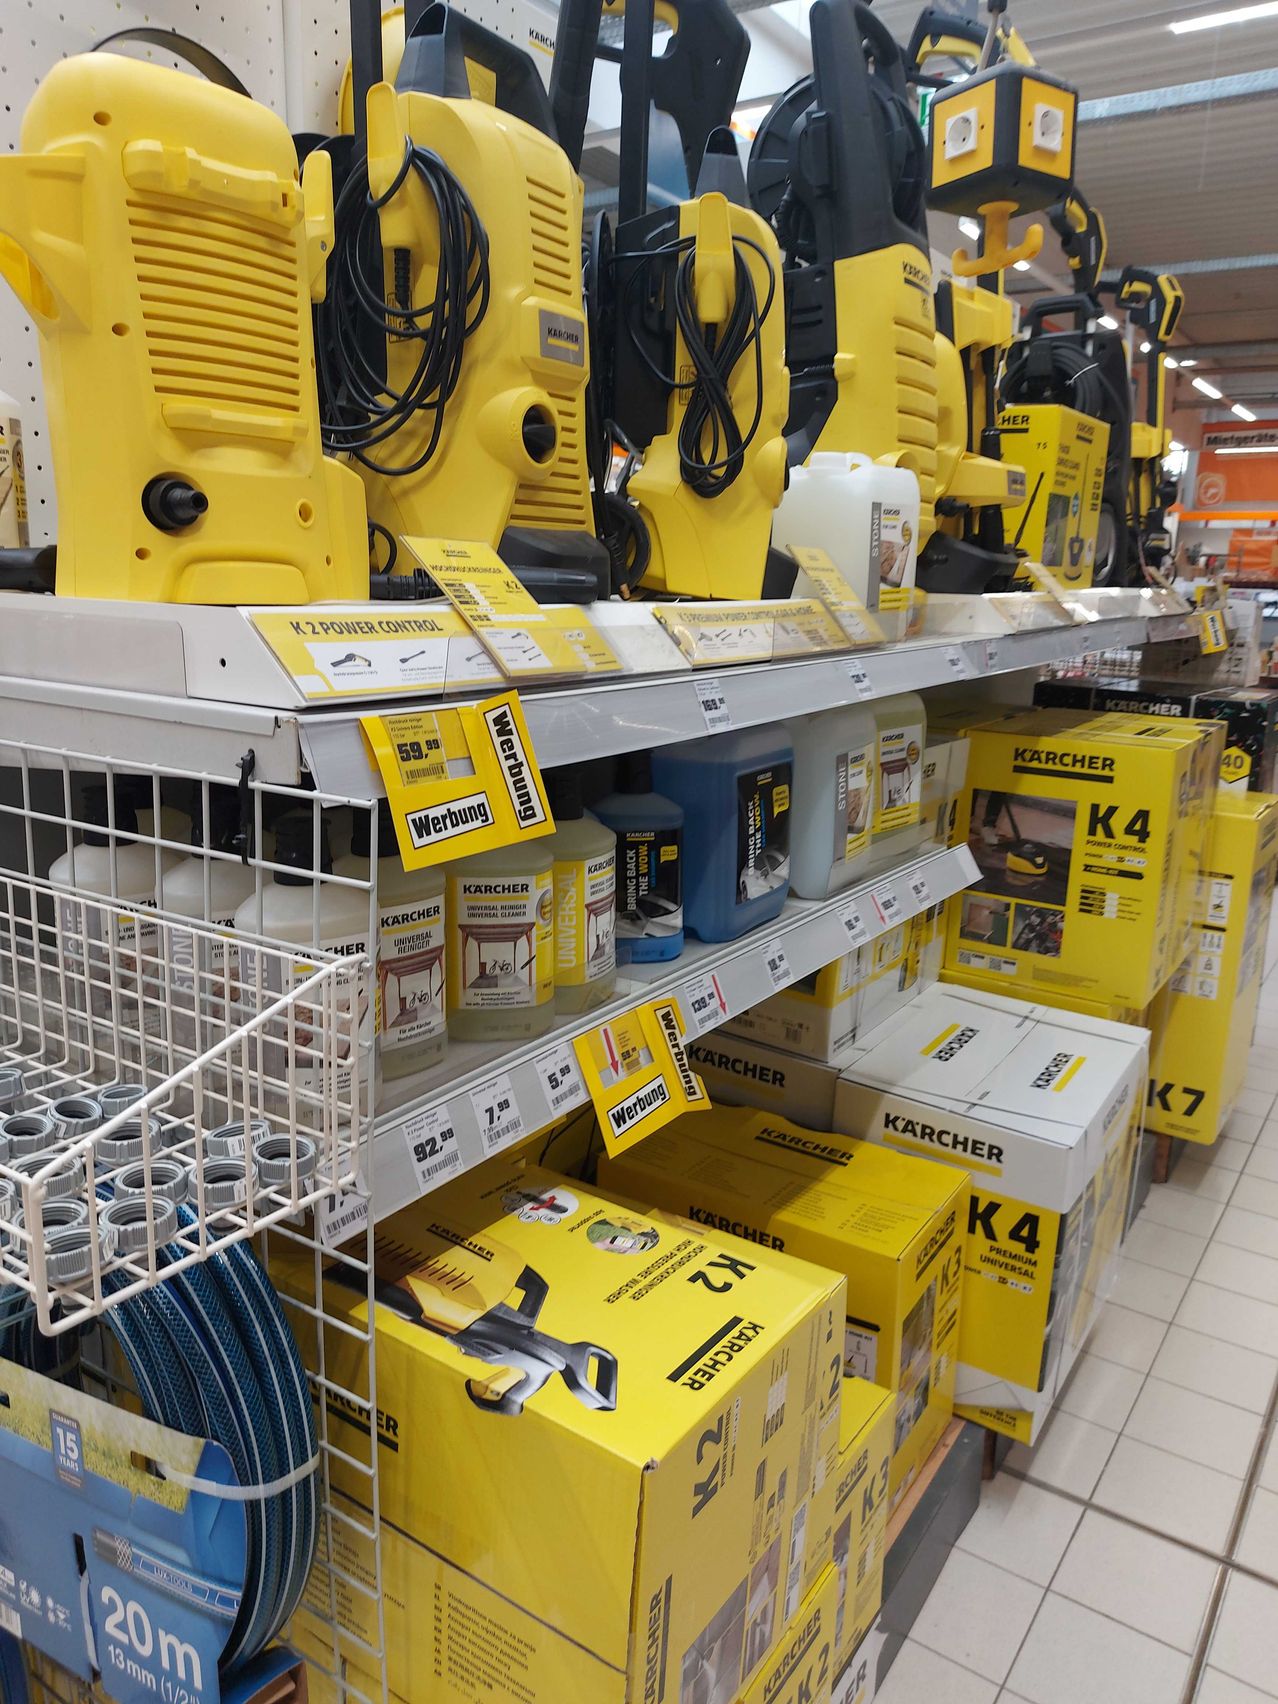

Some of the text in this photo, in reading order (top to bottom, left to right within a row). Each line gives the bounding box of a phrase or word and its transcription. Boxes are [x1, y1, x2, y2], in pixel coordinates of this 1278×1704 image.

[289, 618, 444, 636] K 2 POWER CONTROL
[491, 709, 537, 822] Werbung
[1012, 747, 1116, 772] KÄRCHER
[411, 801, 490, 839] Werbung
[1087, 803, 1151, 844] K 4
[463, 883, 530, 894] KÄRCHER
[626, 849, 636, 912] BRING BACK
[638, 875, 648, 897] THE
[381, 905, 441, 929] KÄRCHER
[466, 903, 527, 912] UNIVERSAL REINIGER
[467, 910, 527, 919] UNIVERSAL CLEANER
[558, 867, 577, 968] UNIVERSAL
[393, 930, 433, 947] UNIVERSAL
[398, 940, 430, 956] REINIGER
[661, 1010, 697, 1097] Werbung
[687, 1044, 786, 1088] KÄRCHER
[1030, 1051, 1074, 1090] KÄRCHER
[547, 1064, 571, 1090] 5,99
[1146, 1078, 1206, 1117] K 7
[485, 1098, 511, 1126] 7,99
[611, 1083, 666, 1129] Werbung
[413, 1127, 455, 1163] 92,99
[760, 1126, 854, 1162] KÄRCHER
[882, 1112, 1004, 1165] KÄRCHER
[687, 1205, 786, 1252] KÄRCHER
[915, 1210, 956, 1270] KÄRCHER
[967, 1194, 1041, 1255] K 4
[686, 1252, 757, 1294] K 2
[940, 1244, 962, 1297] K 3
[979, 1254, 1036, 1280] UNIVERSAL
[989, 1245, 1038, 1268] PREMIUM
[680, 1320, 765, 1392] KÄRCHER
[55, 1427, 79, 1461] 15
[58, 1456, 80, 1473] YEARS
[691, 1414, 724, 1520] K 2
[835, 1449, 869, 1503] RCHER
[861, 1455, 889, 1525] K 3
[101, 1585, 203, 1692] 20 m
[643, 1584, 663, 1704] ÄRCHER
[763, 1607, 821, 1702] KÄRCHER
[107, 1643, 126, 1670] 13
[126, 1656, 157, 1692] mm
[817, 1641, 830, 1688] 2
